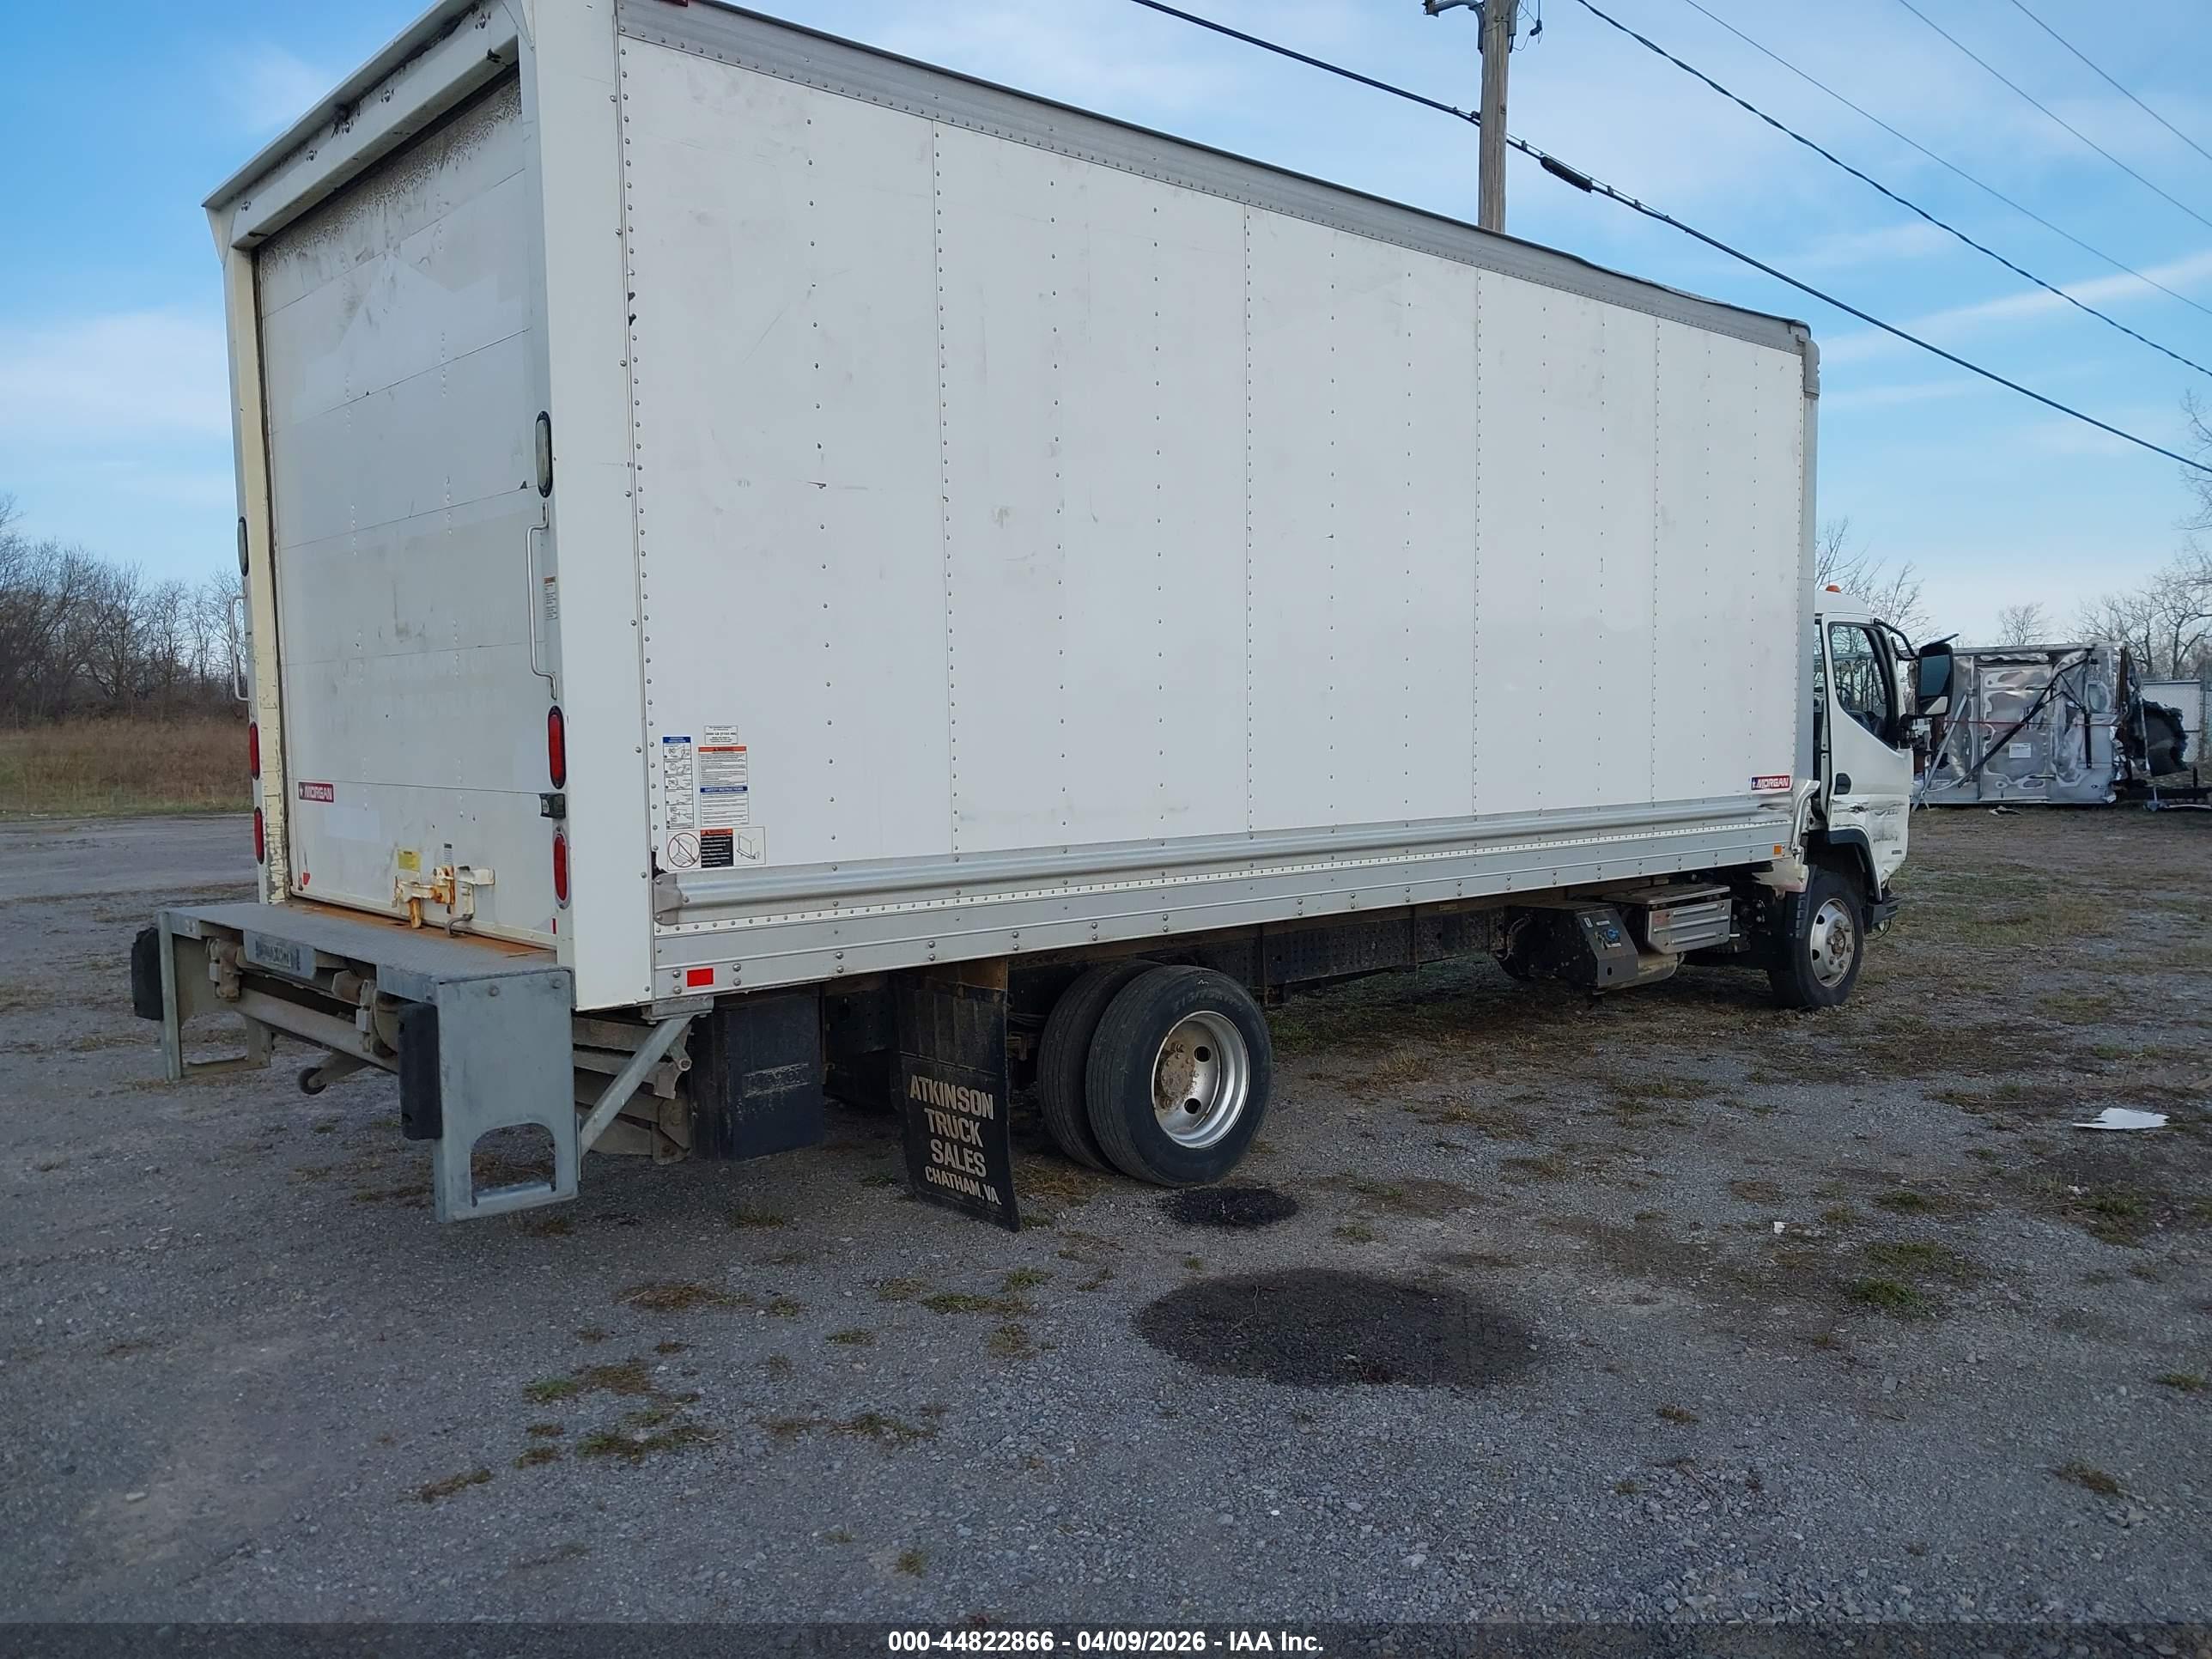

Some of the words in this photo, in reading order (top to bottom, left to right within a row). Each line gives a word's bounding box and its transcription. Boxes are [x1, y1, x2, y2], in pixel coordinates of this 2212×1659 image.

[304, 786, 332, 800] MORGAN
[1756, 777, 1789, 788] MORGAN
[909, 1074, 994, 1120] ATKINSON
[924, 1108, 983, 1148] TRUCK
[930, 1139, 987, 1177] SALES
